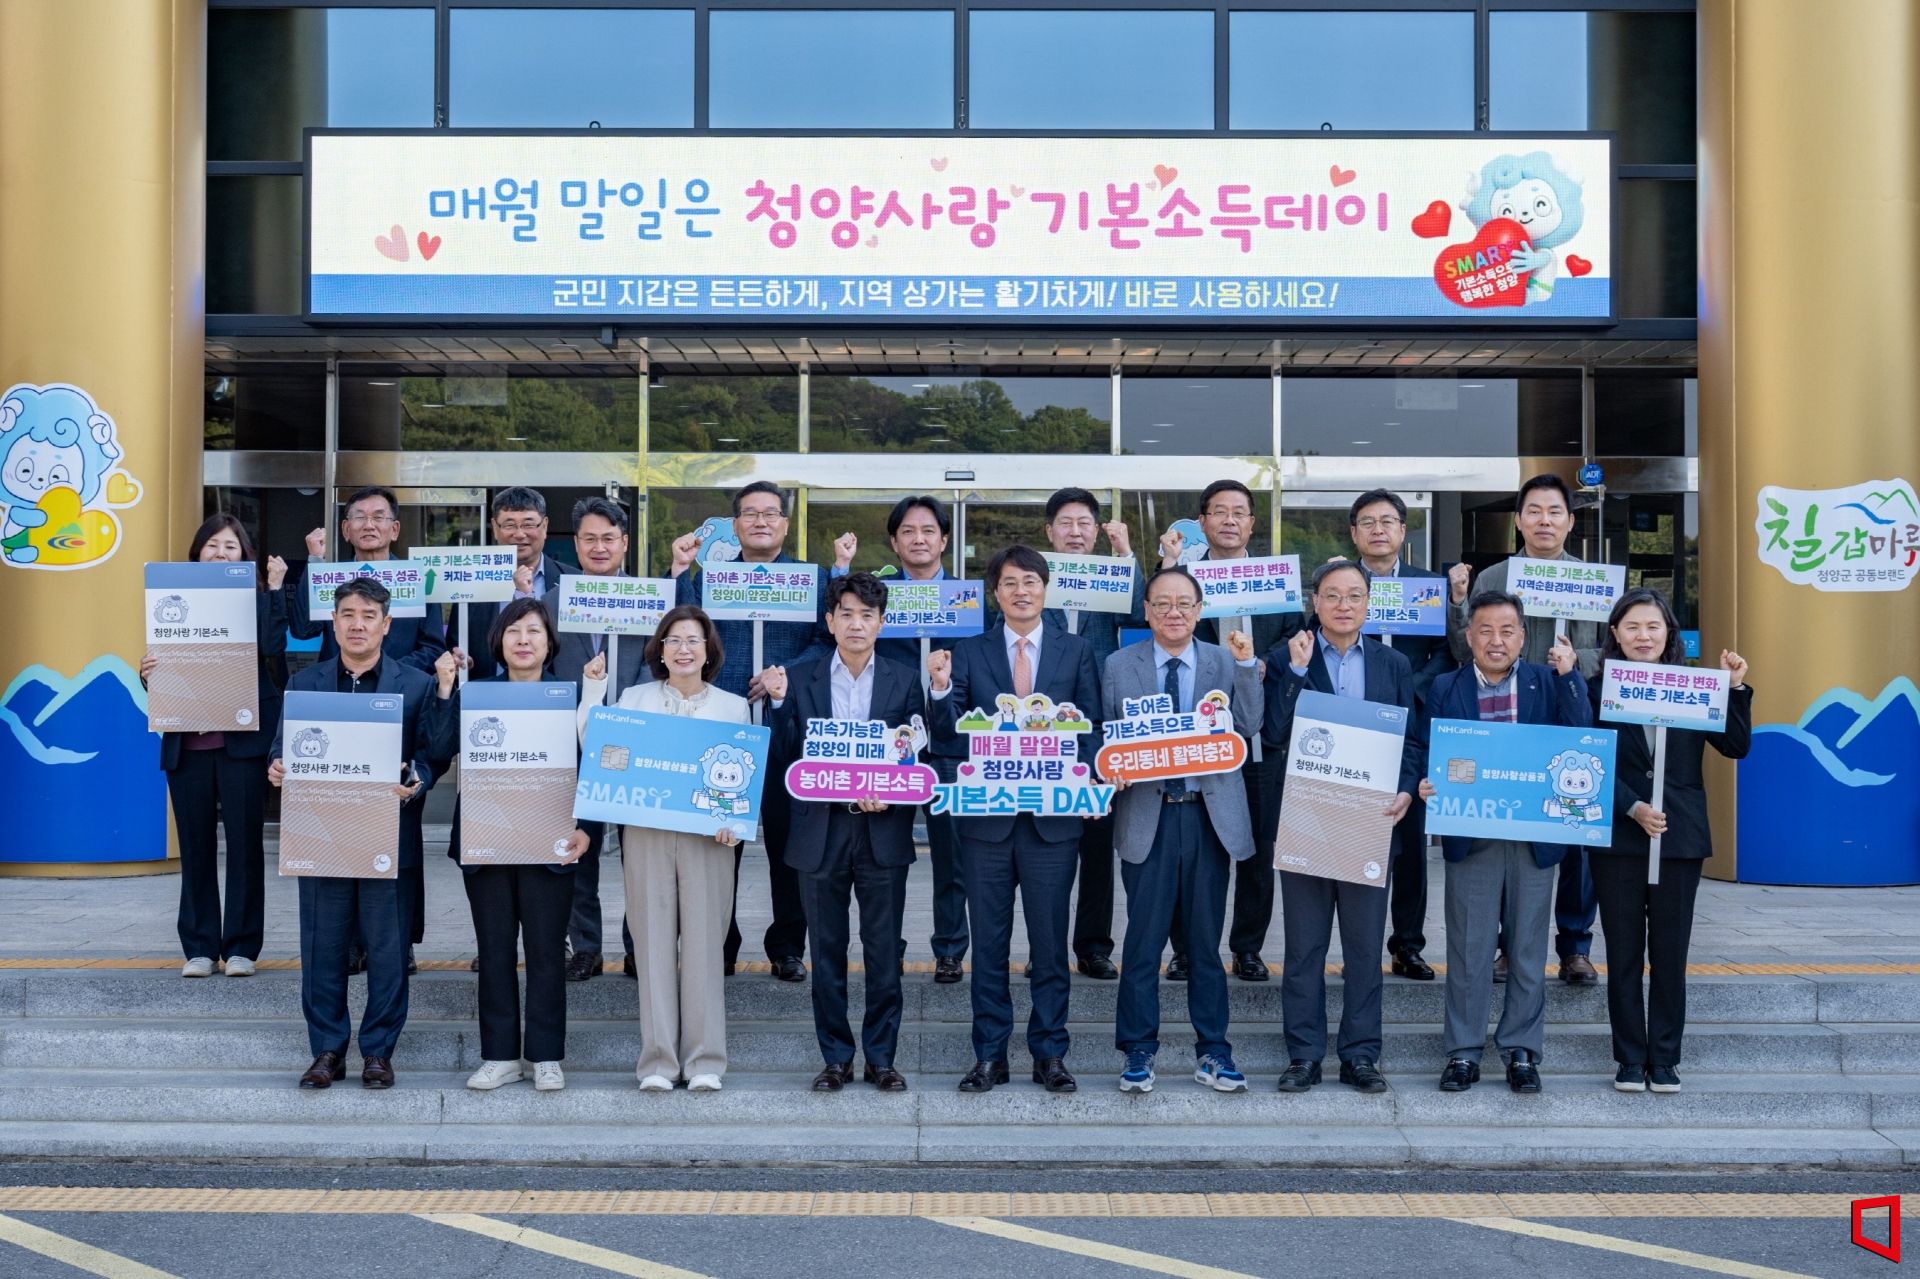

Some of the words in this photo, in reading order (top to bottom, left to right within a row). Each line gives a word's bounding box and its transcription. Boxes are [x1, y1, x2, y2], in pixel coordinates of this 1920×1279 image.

[429, 177, 539, 242] 매월
[560, 177, 721, 241] 말일은
[745, 179, 1010, 249] 청양사랑
[1030, 182, 1389, 254] 기본소득데이
[552, 279, 609, 308] 군민
[616, 279, 701, 308] 지갑은
[708, 279, 829, 311] 든든하게,
[838, 279, 893, 308] 지역
[902, 279, 985, 309] 상가는
[994, 279, 1116, 310] 활기차게!
[1125, 280, 1178, 309] 바로
[1189, 280, 1339, 310] 사용하세요!
[1460, 283, 1495, 303] 행복한
[1496, 273, 1519, 292] 청양
[1585, 470, 1600, 479] ADT
[493, 553, 514, 566] 함께
[312, 571, 346, 585] 농어촌
[396, 569, 421, 583] 성공,
[443, 570, 473, 582] 커지는
[474, 569, 513, 582] 지역상권
[1058, 561, 1108, 575] 기본소득과
[1110, 565, 1132, 577] 함께
[1193, 566, 1229, 581] 작지만
[1231, 564, 1265, 579] 든든한
[1267, 562, 1294, 577] 변화,
[1523, 563, 1558, 578] 농어촌
[1560, 566, 1609, 583] 기본소득,
[1817, 569, 1852, 583] 청양군
[1855, 569, 1906, 583] 공동브랜드
[705, 571, 740, 584] 농어촌
[741, 571, 786, 585] 기본소득
[788, 573, 814, 586] 성공,
[1057, 577, 1087, 590] 커지는
[1089, 579, 1130, 593] 지역상권
[1203, 581, 1239, 596] 농어촌
[1241, 577, 1287, 593] 기본소득
[574, 580, 612, 596] 농어촌
[612, 582, 660, 598] 기본소득,
[711, 588, 746, 602] 청양이
[747, 589, 808, 603] 앞장섭니다!
[908, 585, 939, 597] 지역도
[1371, 582, 1402, 594] 지역도
[1516, 579, 1583, 595] 지역순환경제의
[1585, 584, 1614, 598] 마중물
[568, 596, 635, 610] 지역순환경제의
[637, 597, 666, 611] 마중물
[911, 611, 957, 624] 기본소득
[1374, 608, 1419, 622] 기본소득
[153, 627, 190, 639] 청양사랑
[192, 627, 229, 638] 기본소득
[1610, 667, 1649, 685] 작지만
[1651, 672, 1690, 689] 든든한
[1692, 676, 1721, 692] 변화,
[1619, 685, 1657, 702] 농어촌
[1661, 688, 1711, 707] 기본소득
[1125, 696, 1171, 717] 농어촌
[808, 720, 885, 740] 지속가능한
[1105, 715, 1195, 740] 기본소득으로
[805, 741, 851, 759] 청양의
[855, 742, 885, 760] 미래
[971, 735, 1012, 757] 매월
[1019, 734, 1076, 757] 말일은
[469, 751, 508, 763] 청양사랑
[510, 751, 548, 762] 기본소득
[634, 757, 698, 774] 청양사랑상품권
[1108, 747, 1170, 774] 우리동네
[1172, 740, 1235, 767] 활력충전
[290, 762, 330, 775] 청양사랑
[331, 763, 371, 776] 기본소득
[982, 759, 1064, 781] 청양사랑
[1296, 759, 1333, 776] 청양사랑
[1334, 766, 1371, 782] 기본소득
[1482, 768, 1547, 783] 청양사랑상품권
[799, 768, 852, 791] 농어촌
[856, 771, 926, 794] 기본소득
[931, 785, 1044, 815] 기본소득
[1053, 787, 1111, 814] DAY
